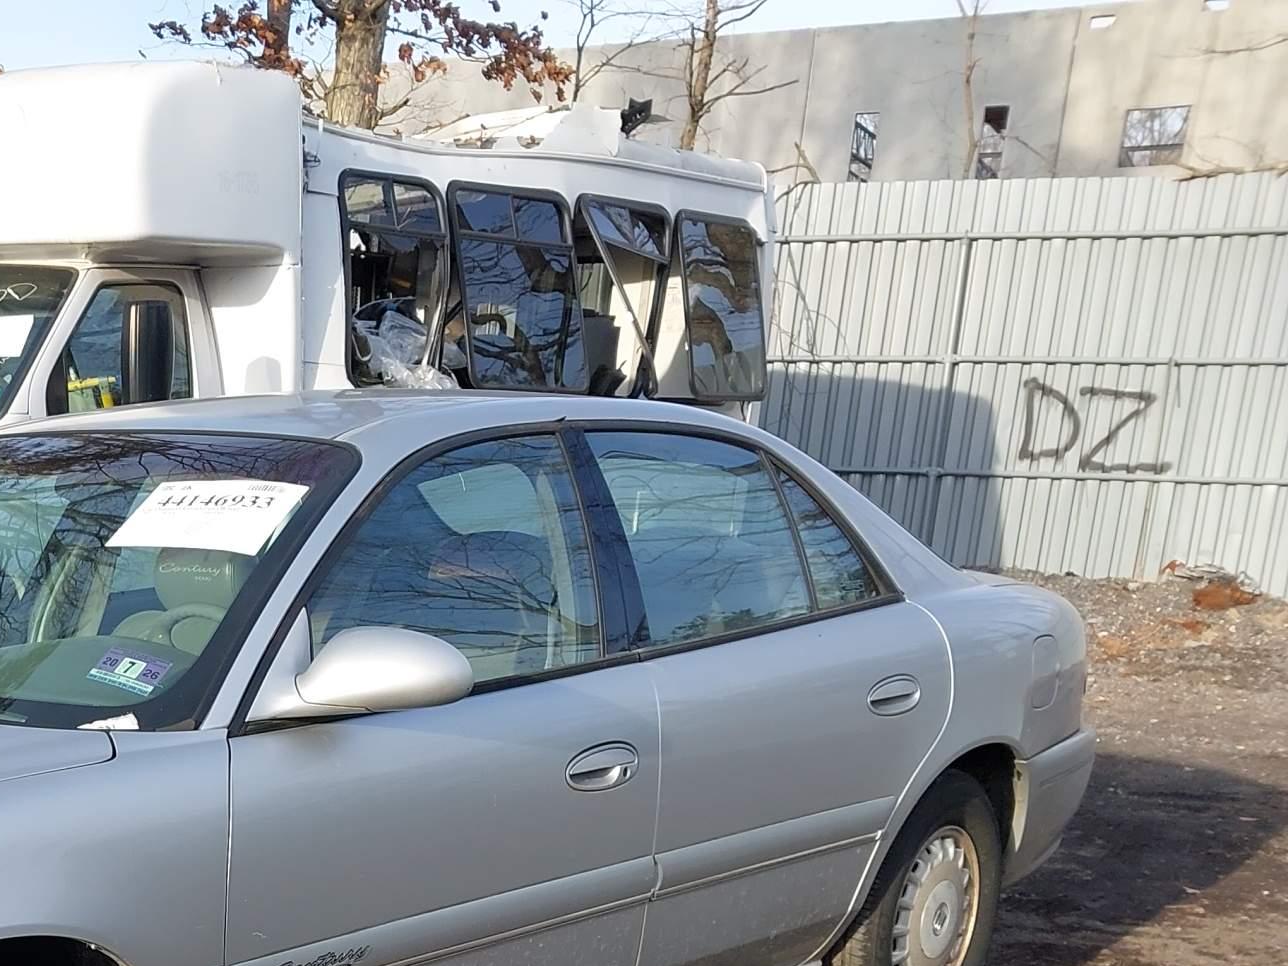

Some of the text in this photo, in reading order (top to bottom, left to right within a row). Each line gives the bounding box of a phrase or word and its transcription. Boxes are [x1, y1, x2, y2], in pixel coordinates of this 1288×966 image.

[1018, 377, 1173, 475] DZ
[158, 494, 276, 509] 44146933
[102, 656, 119, 668] 20
[123, 660, 137, 673] 7
[142, 669, 160, 680] 26
